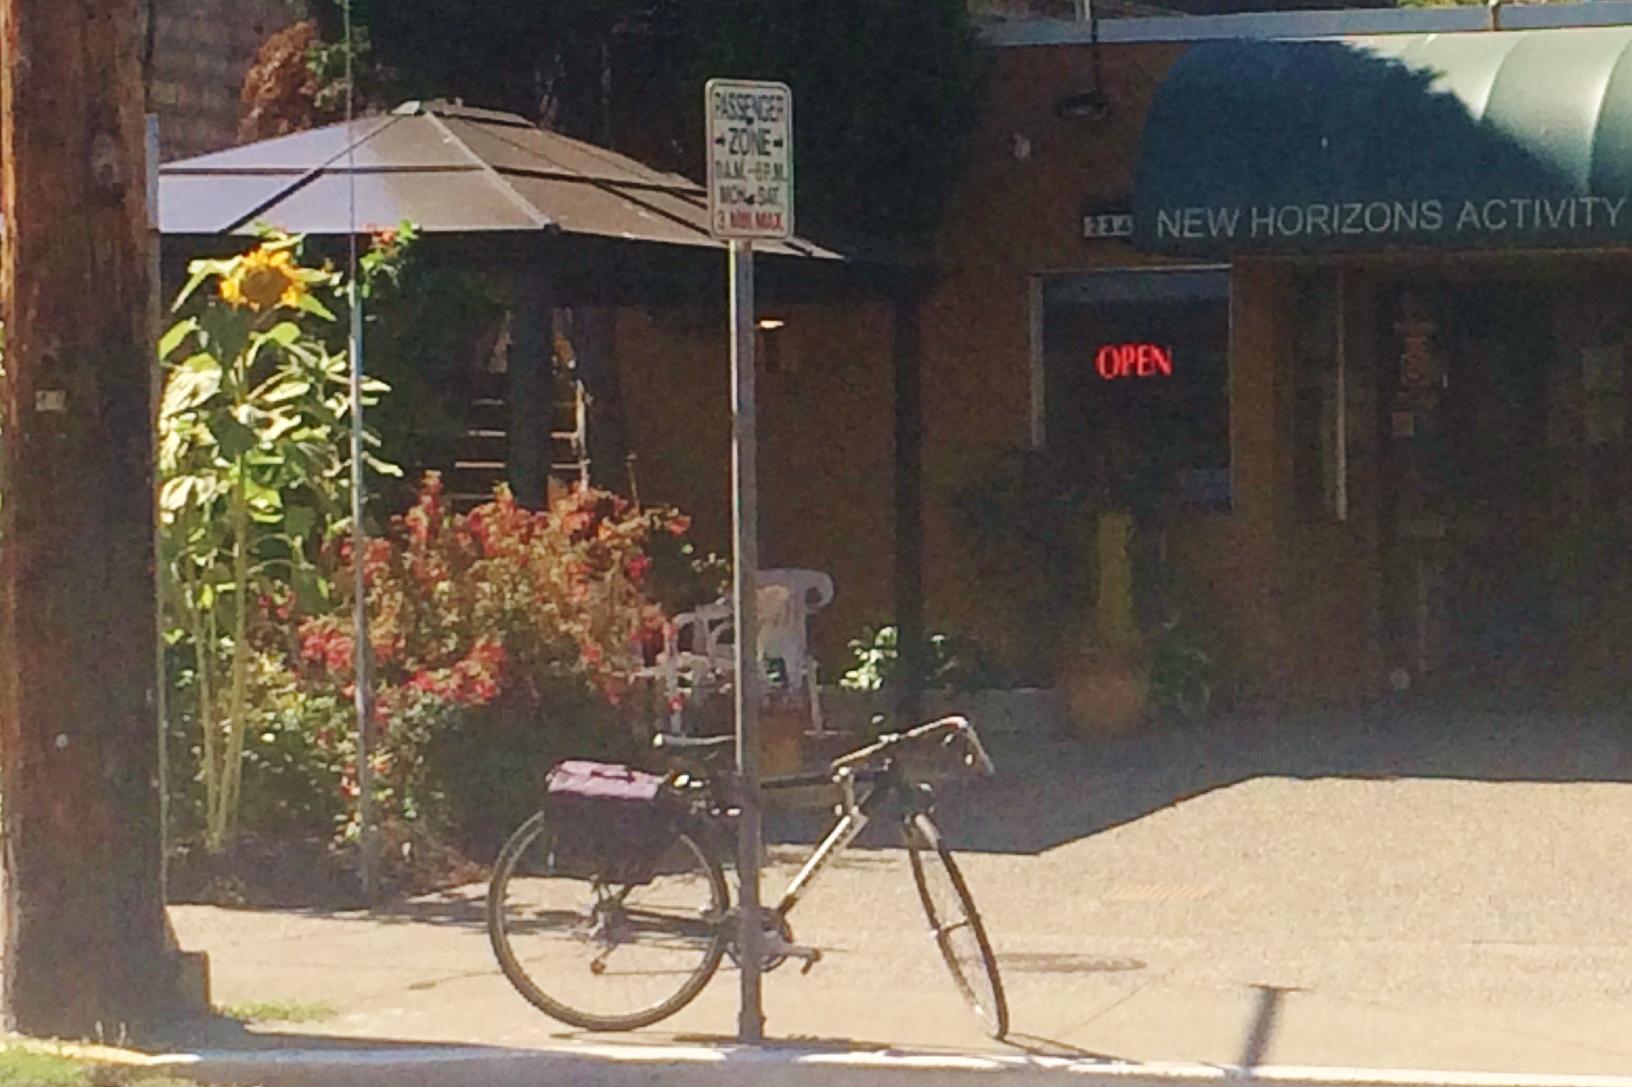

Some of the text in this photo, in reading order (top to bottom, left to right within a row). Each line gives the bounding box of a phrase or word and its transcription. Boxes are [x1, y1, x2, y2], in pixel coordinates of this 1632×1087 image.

[715, 91, 784, 121] PASSENGER
[728, 127, 771, 156] ZONE
[1156, 206, 1241, 238] NEW
[1250, 199, 1443, 237] HORIZONS
[1456, 196, 1629, 231] ACTIVITY
[1095, 344, 1173, 380] OPEN
